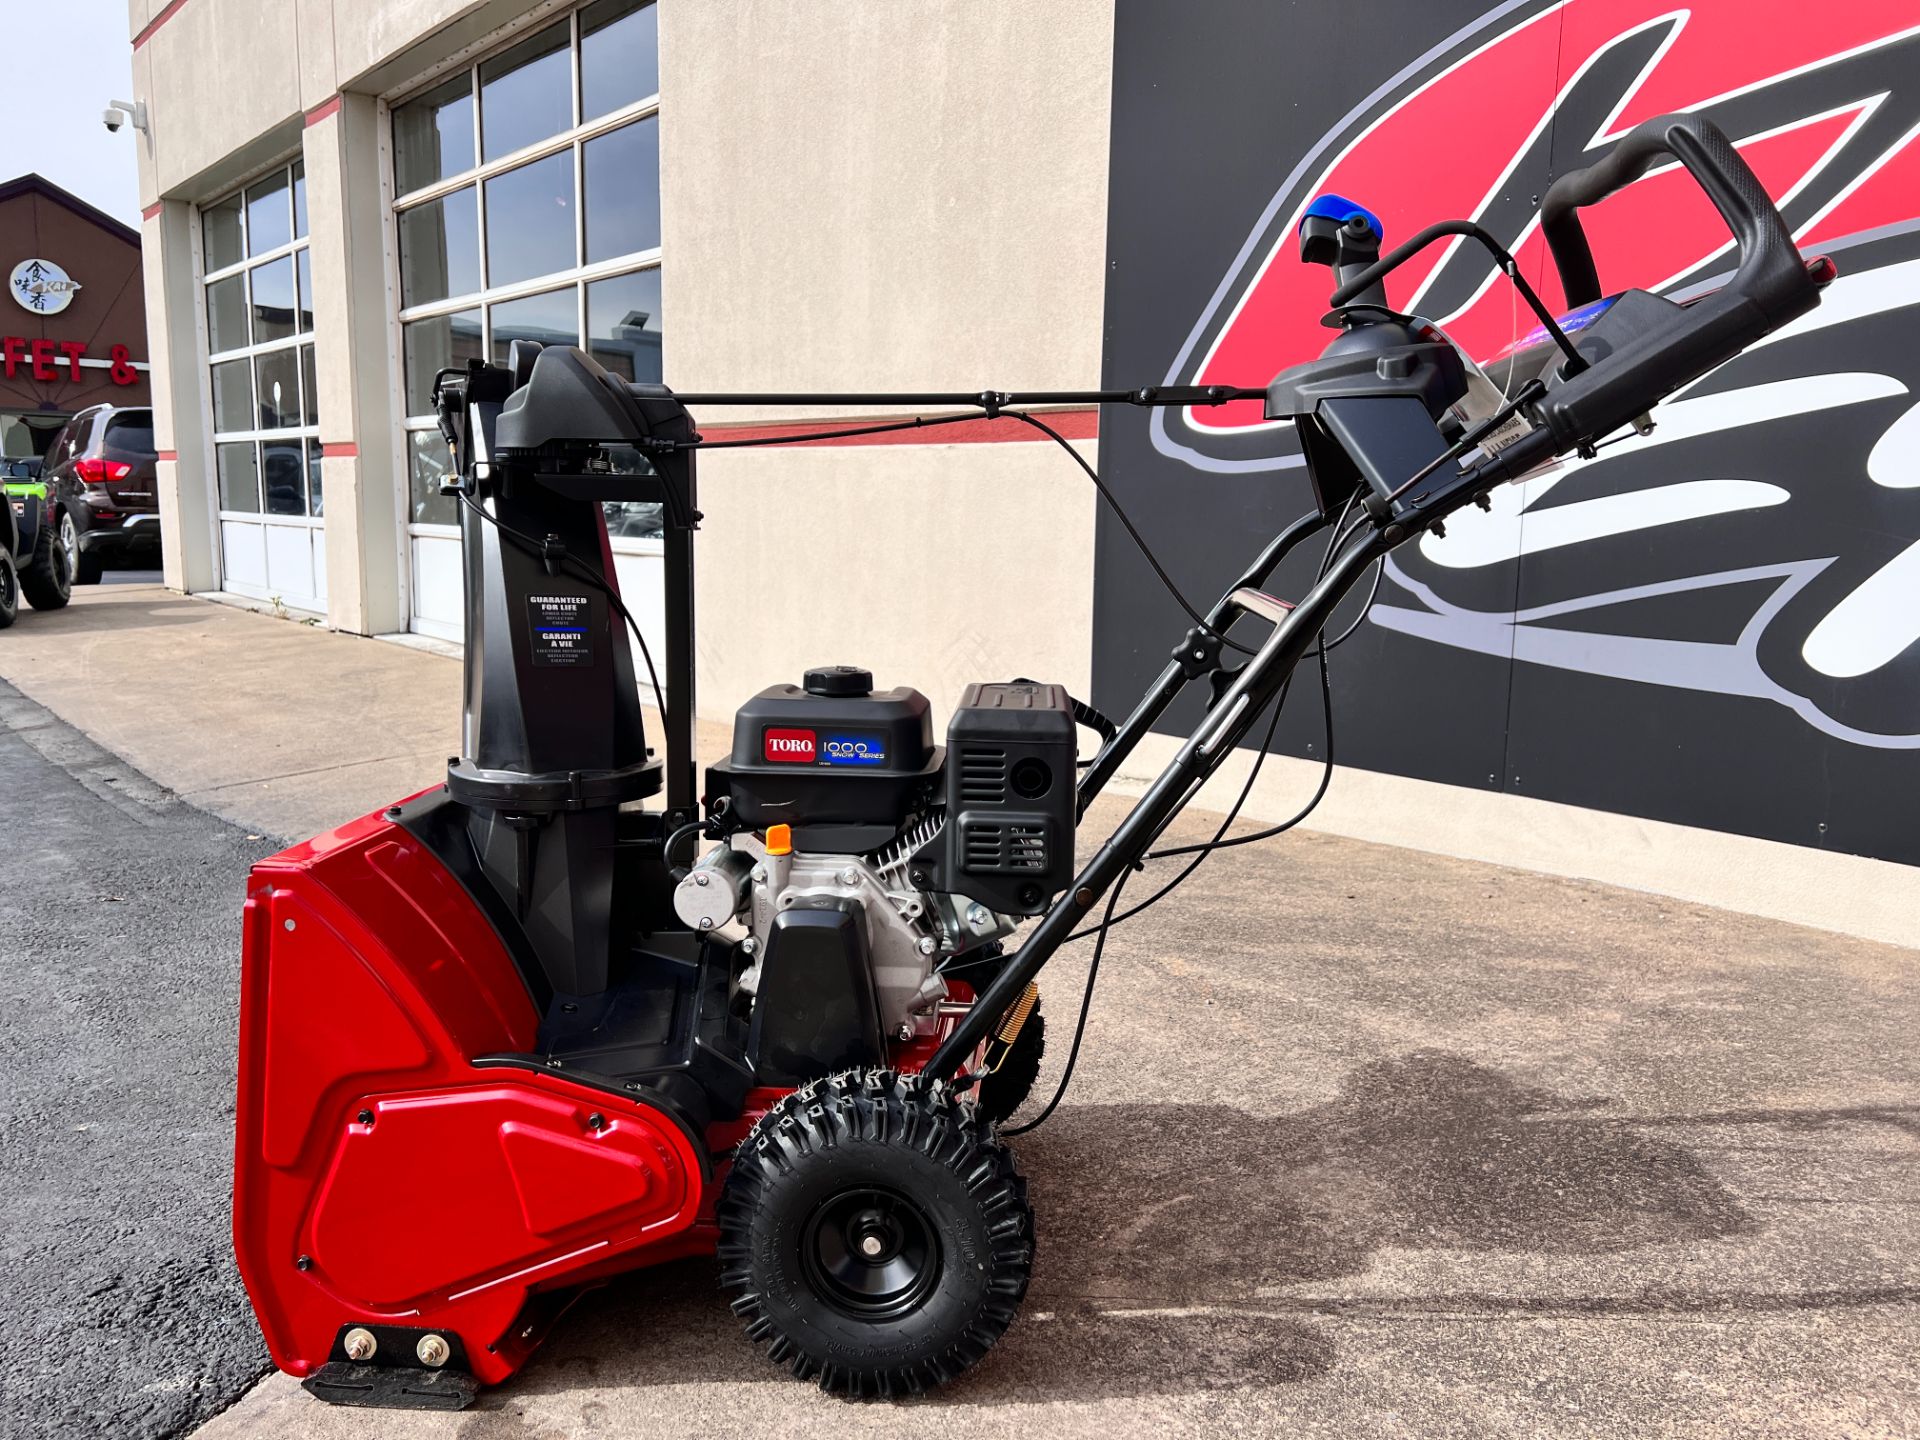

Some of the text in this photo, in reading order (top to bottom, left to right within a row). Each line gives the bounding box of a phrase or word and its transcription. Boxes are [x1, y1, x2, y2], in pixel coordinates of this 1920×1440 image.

[4, 336, 139, 385] FET &
[530, 596, 587, 604] GUARANTEED
[558, 640, 574, 648] VIE
[769, 739, 868, 754] TORO 1000
